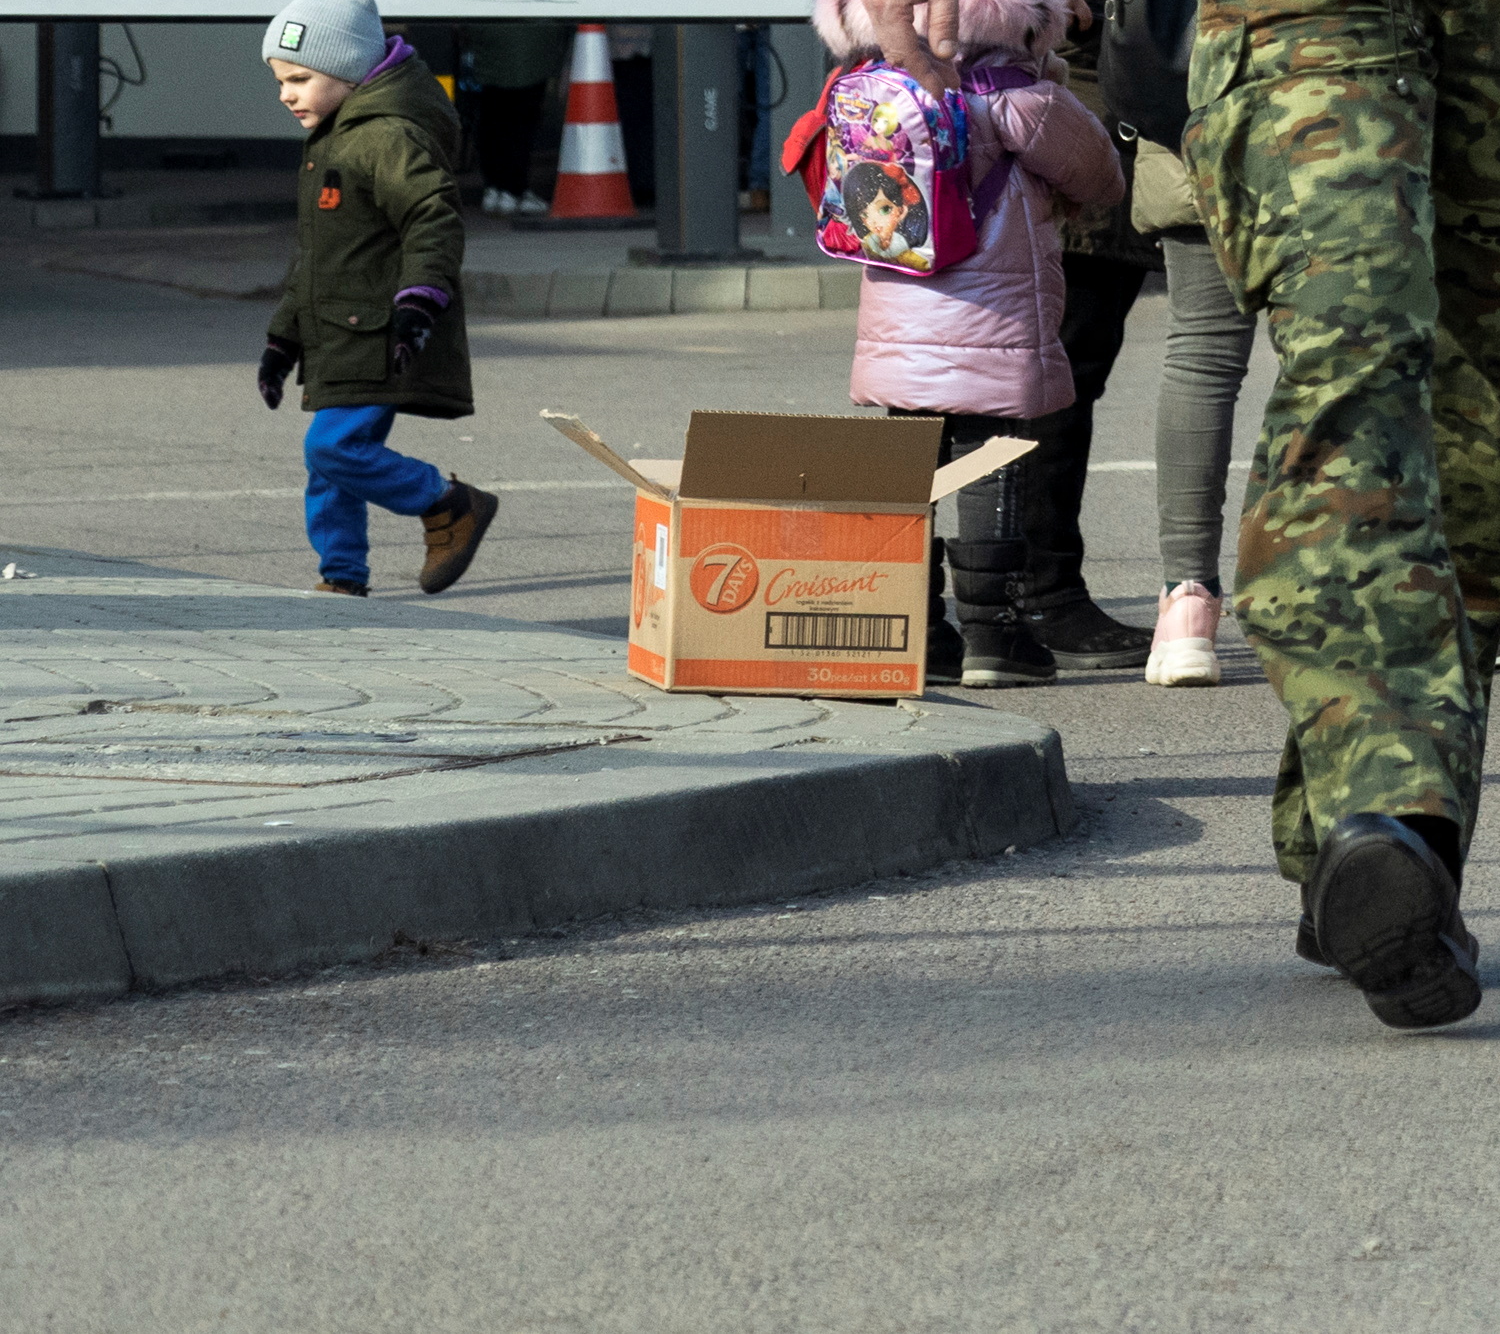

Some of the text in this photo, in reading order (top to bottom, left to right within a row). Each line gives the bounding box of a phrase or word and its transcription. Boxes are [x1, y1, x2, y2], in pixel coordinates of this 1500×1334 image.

[703, 554, 743, 607] 7
[721, 558, 754, 605] DAYS
[764, 568, 889, 606] Croissant
